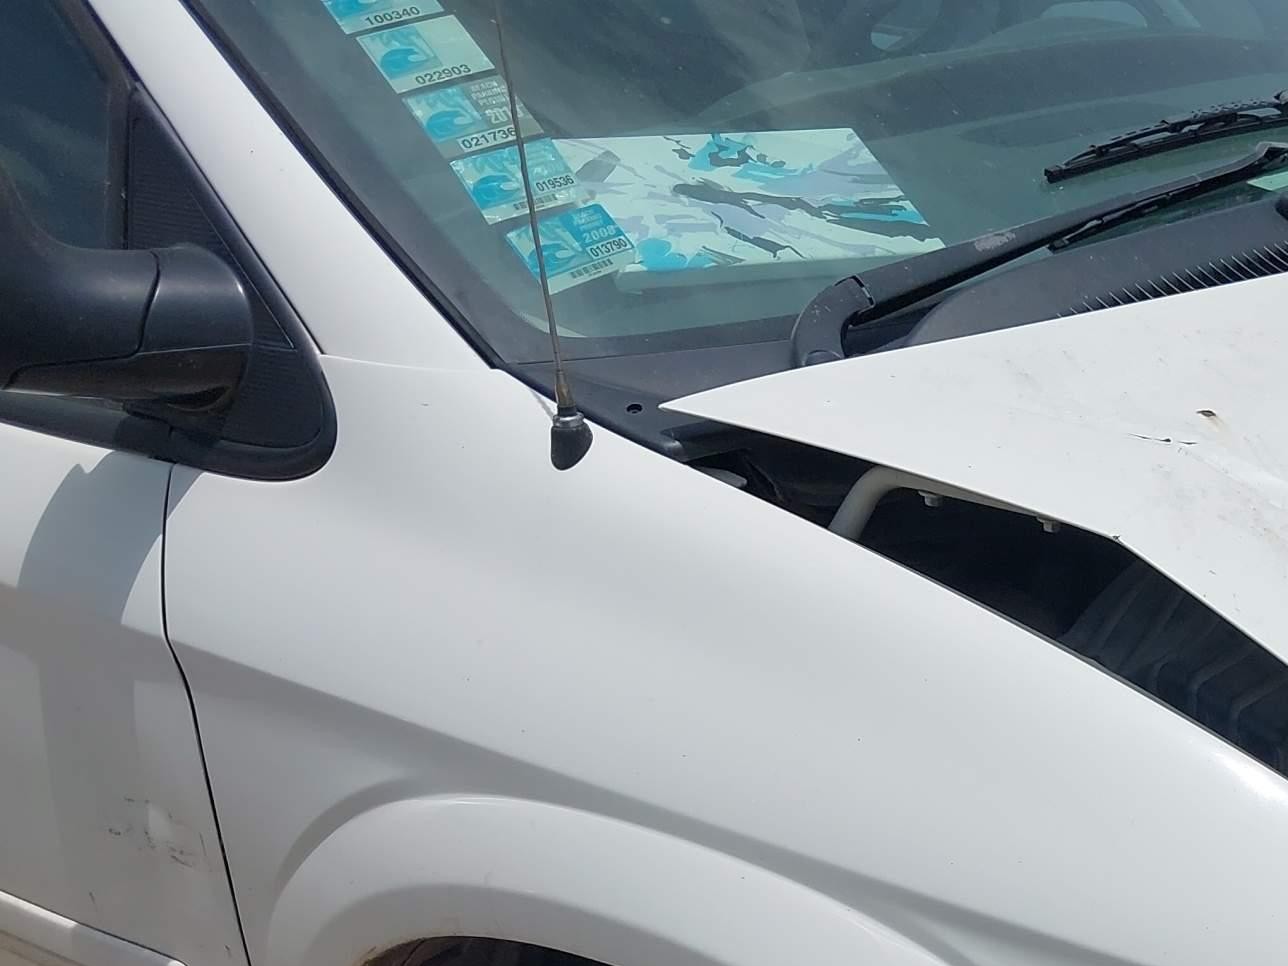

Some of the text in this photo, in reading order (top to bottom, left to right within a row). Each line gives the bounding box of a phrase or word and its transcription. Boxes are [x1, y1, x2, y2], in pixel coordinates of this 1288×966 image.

[365, 6, 421, 26] 100340
[415, 64, 472, 85] 022903
[461, 127, 516, 149] 021736
[535, 175, 575, 192] 019536
[589, 238, 628, 258] 013790
